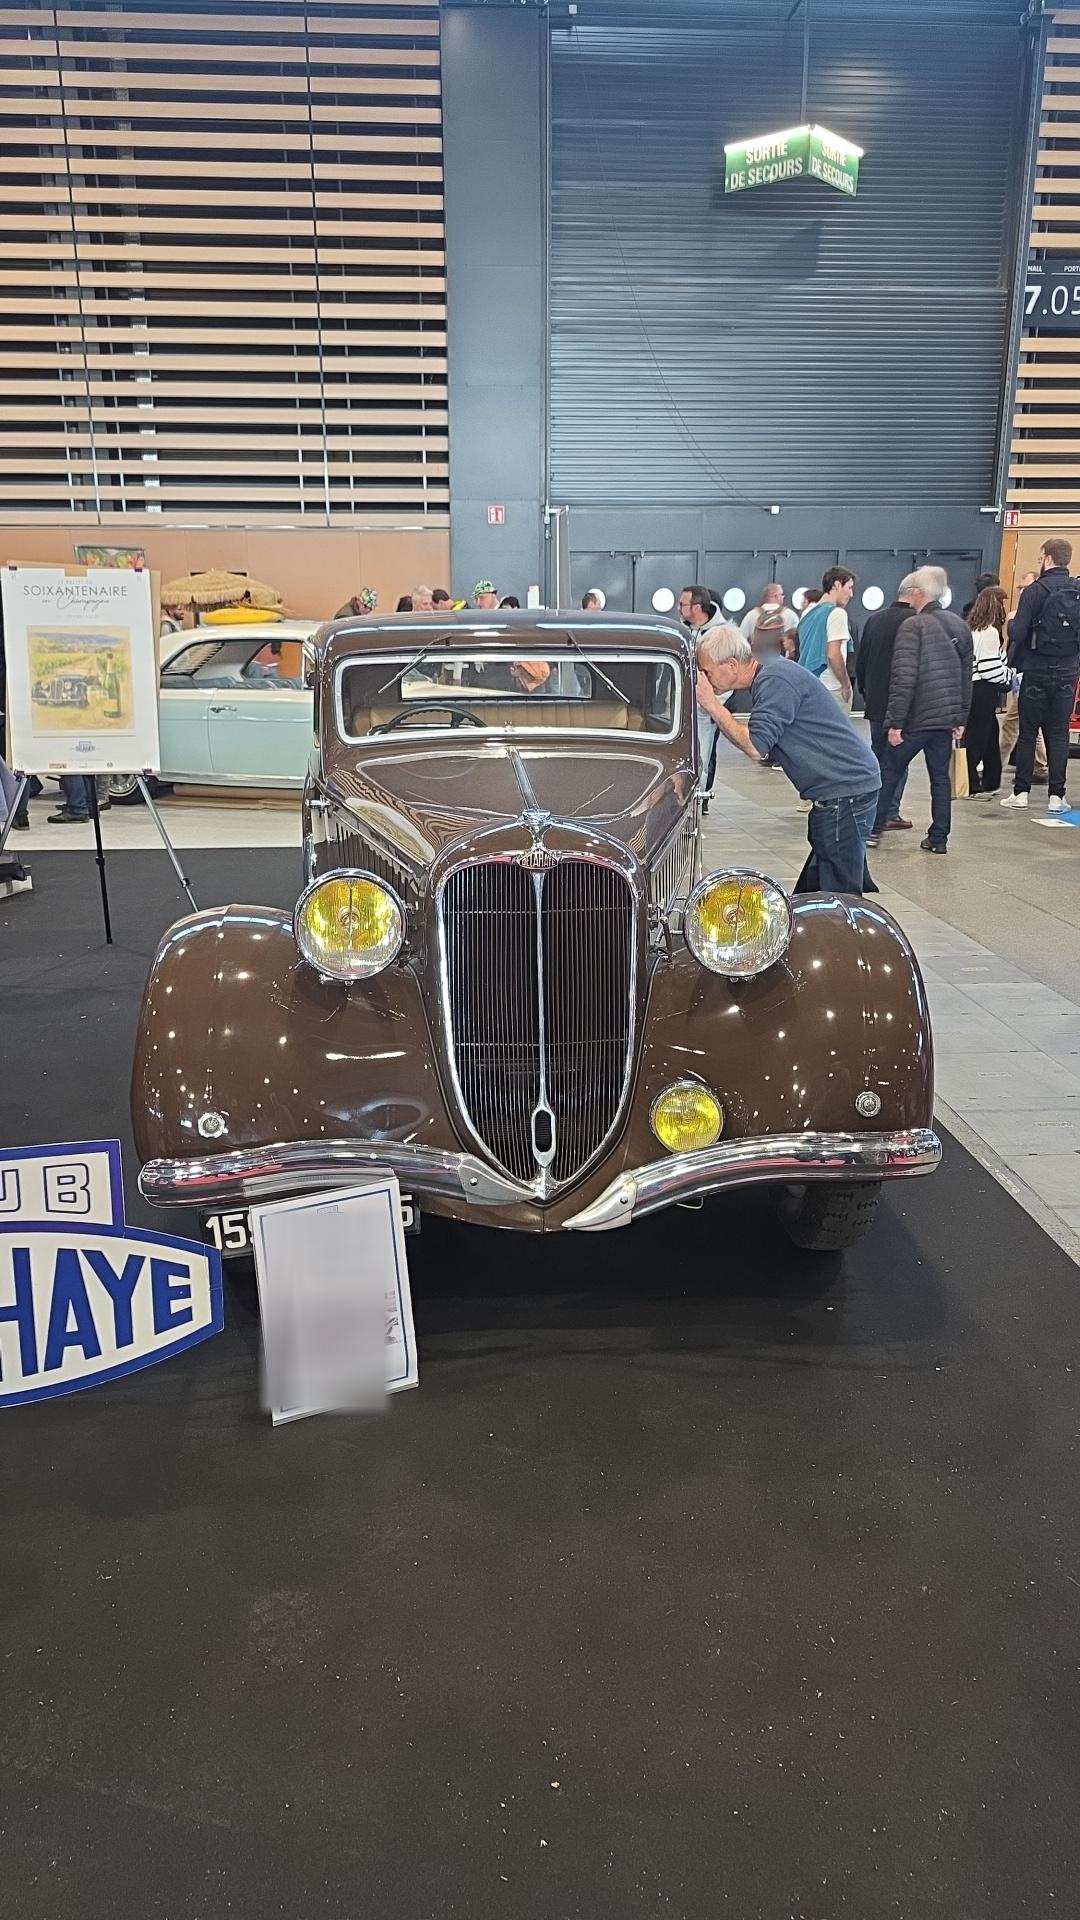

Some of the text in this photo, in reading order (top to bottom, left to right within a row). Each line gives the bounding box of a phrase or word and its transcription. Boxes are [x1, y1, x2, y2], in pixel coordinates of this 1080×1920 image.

[745, 141, 788, 164] SORTIE
[821, 143, 847, 166] SORTIE
[730, 157, 803, 190] DE SECOURS
[811, 155, 854, 193] DE SECOURS
[1027, 265, 1080, 273] HALL PORT
[1025, 285, 1080, 315] 7.05
[23, 585, 128, 597] SOIXANTENAIRE
[206, 1213, 254, 1250] 15
